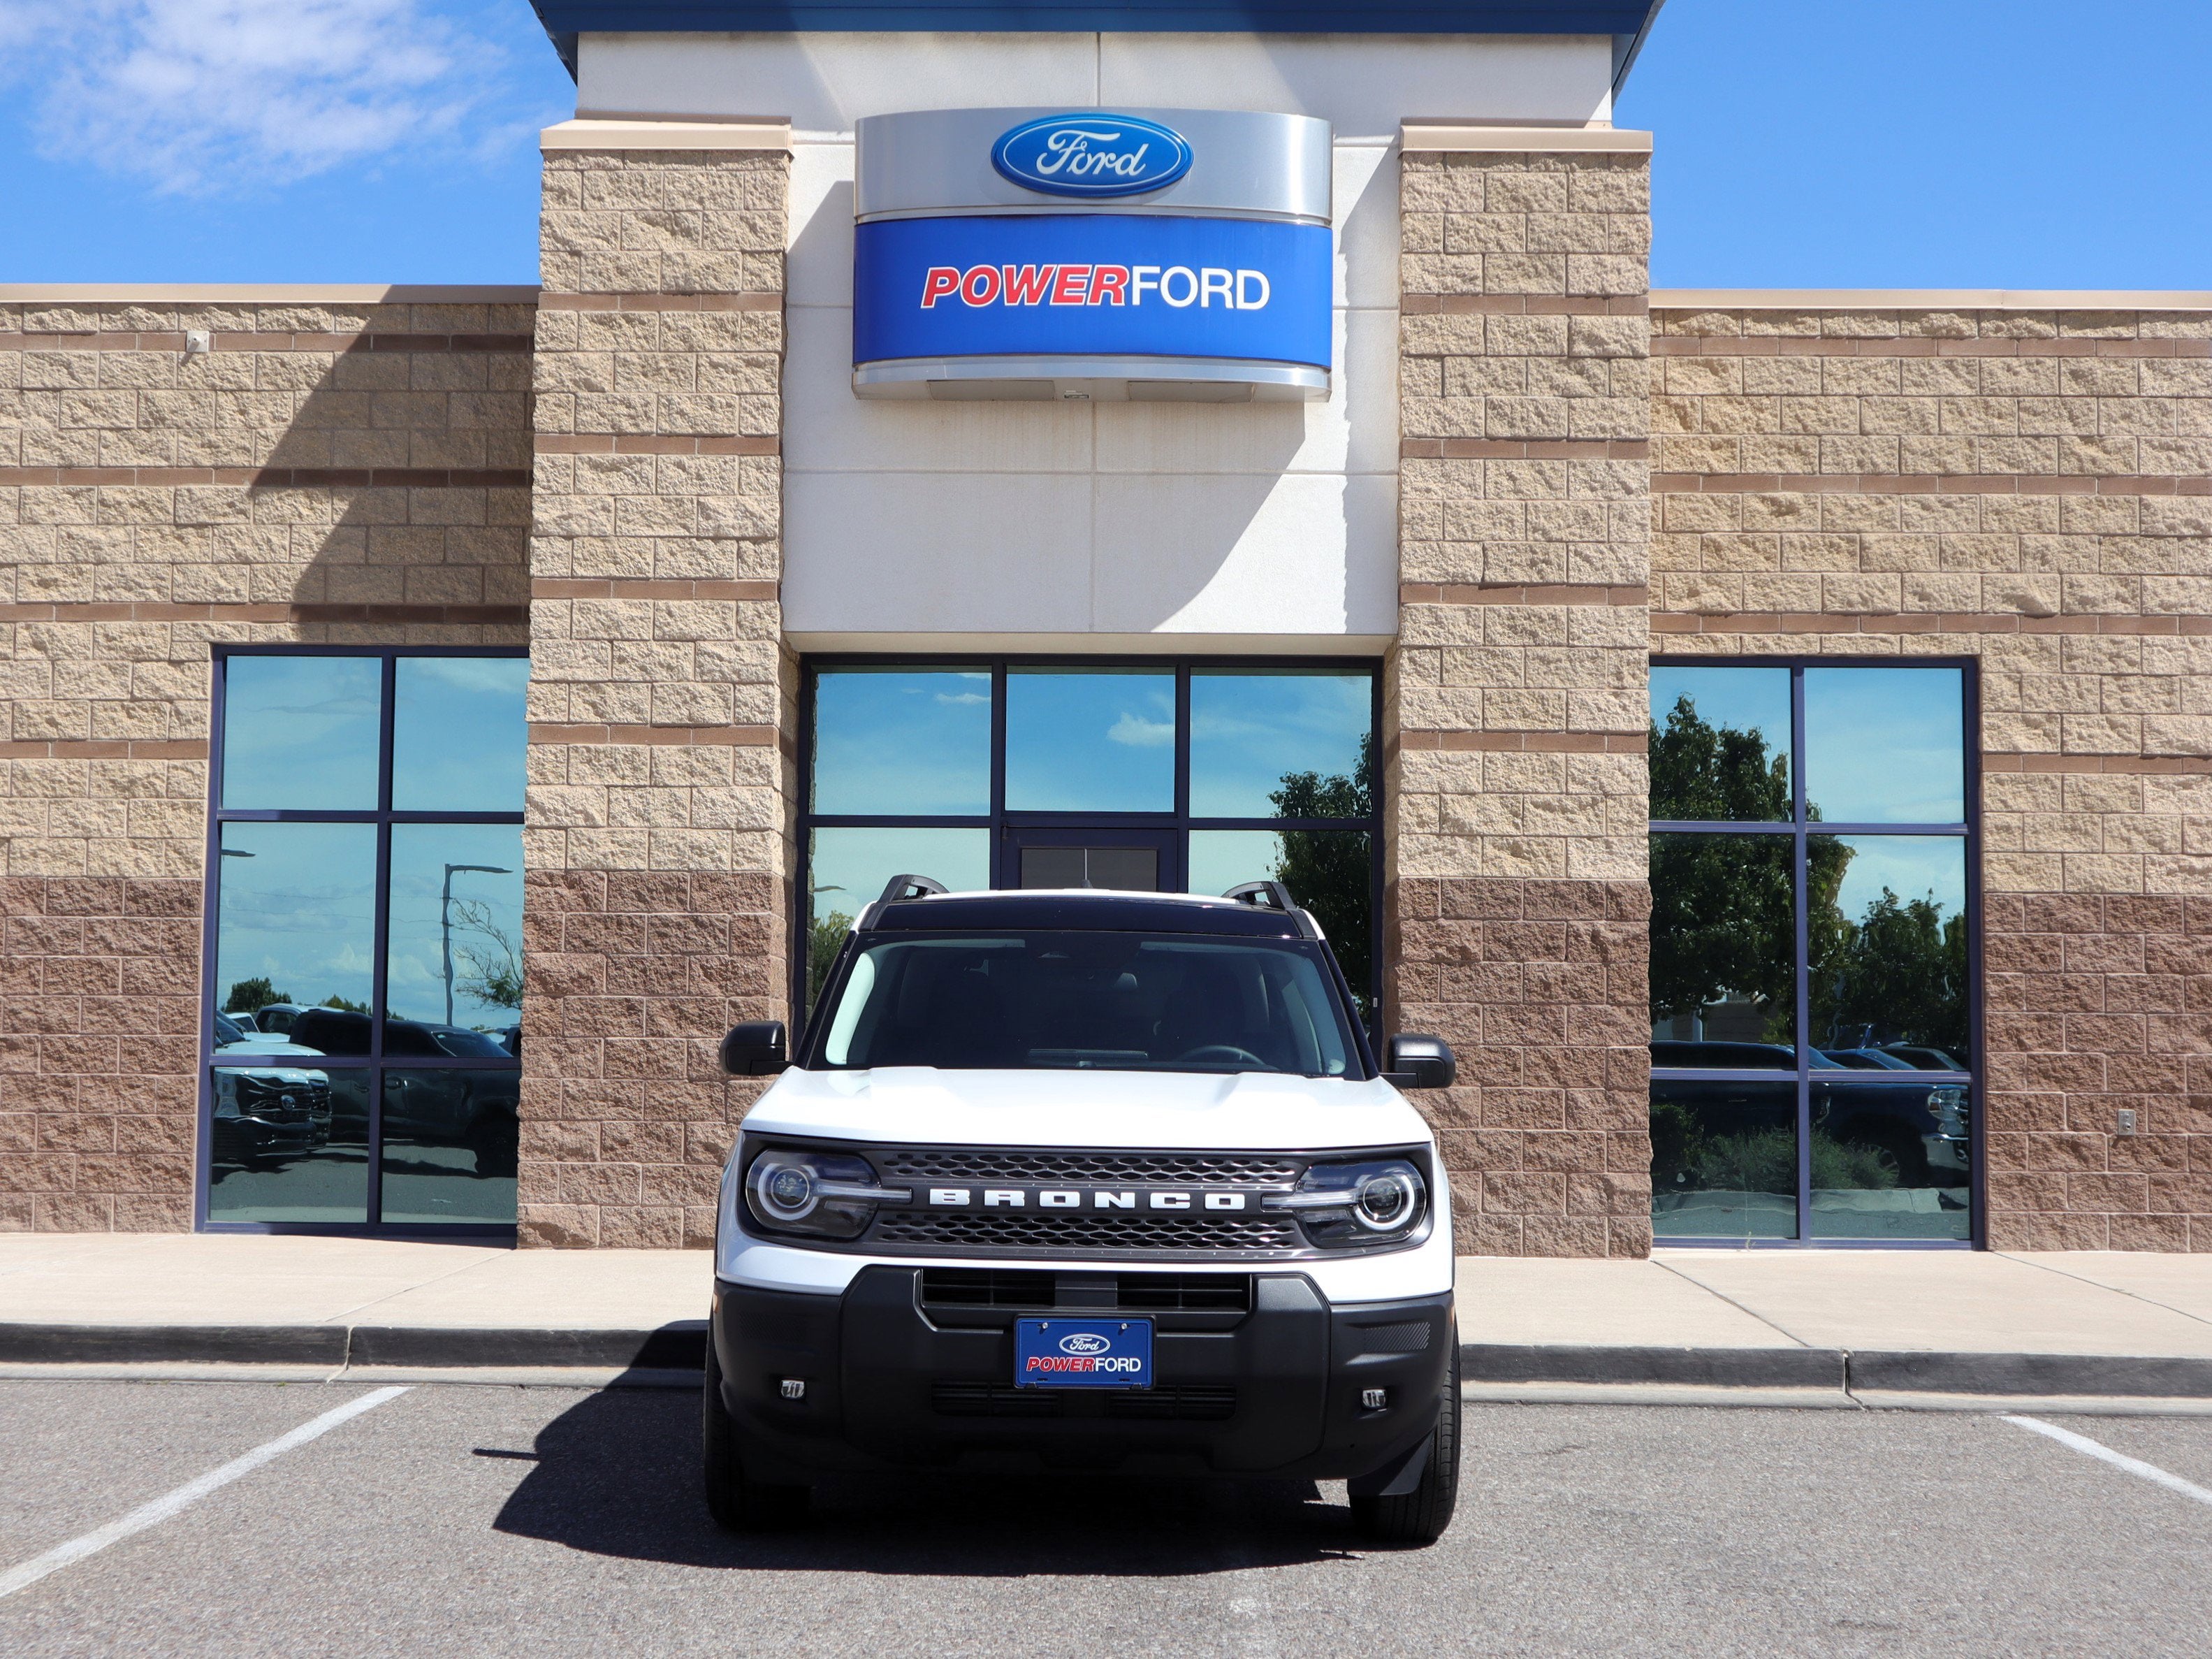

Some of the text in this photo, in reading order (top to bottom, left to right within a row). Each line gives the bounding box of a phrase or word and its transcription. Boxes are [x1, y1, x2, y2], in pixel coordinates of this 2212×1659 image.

[1035, 130, 1148, 176] Ford
[930, 1189, 1245, 1210] BRONCO
[1070, 1338, 1099, 1350] Ford
